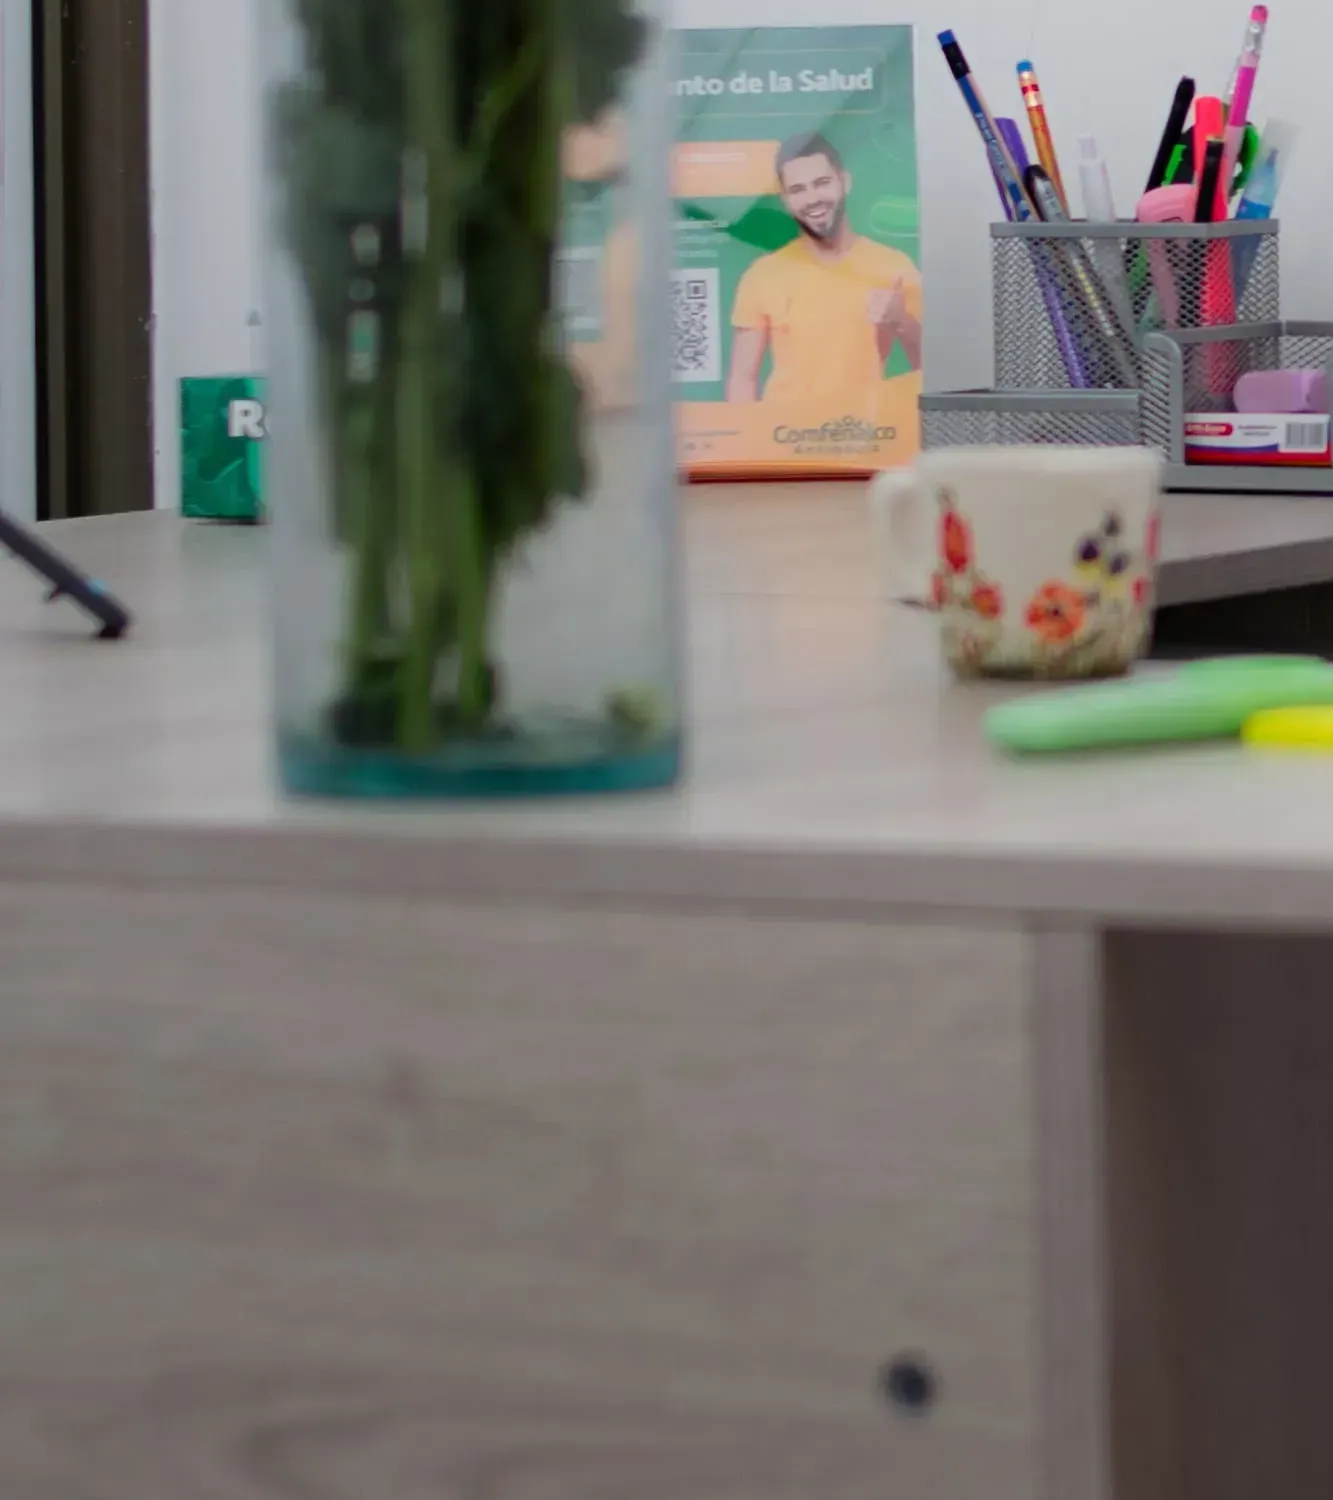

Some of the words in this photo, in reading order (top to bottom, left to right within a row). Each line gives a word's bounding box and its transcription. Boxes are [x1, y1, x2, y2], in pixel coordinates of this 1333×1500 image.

[674, 75, 725, 96] nto
[729, 71, 763, 94] de
[769, 69, 793, 94] la
[798, 67, 874, 92] Salud
[227, 399, 270, 439] R
